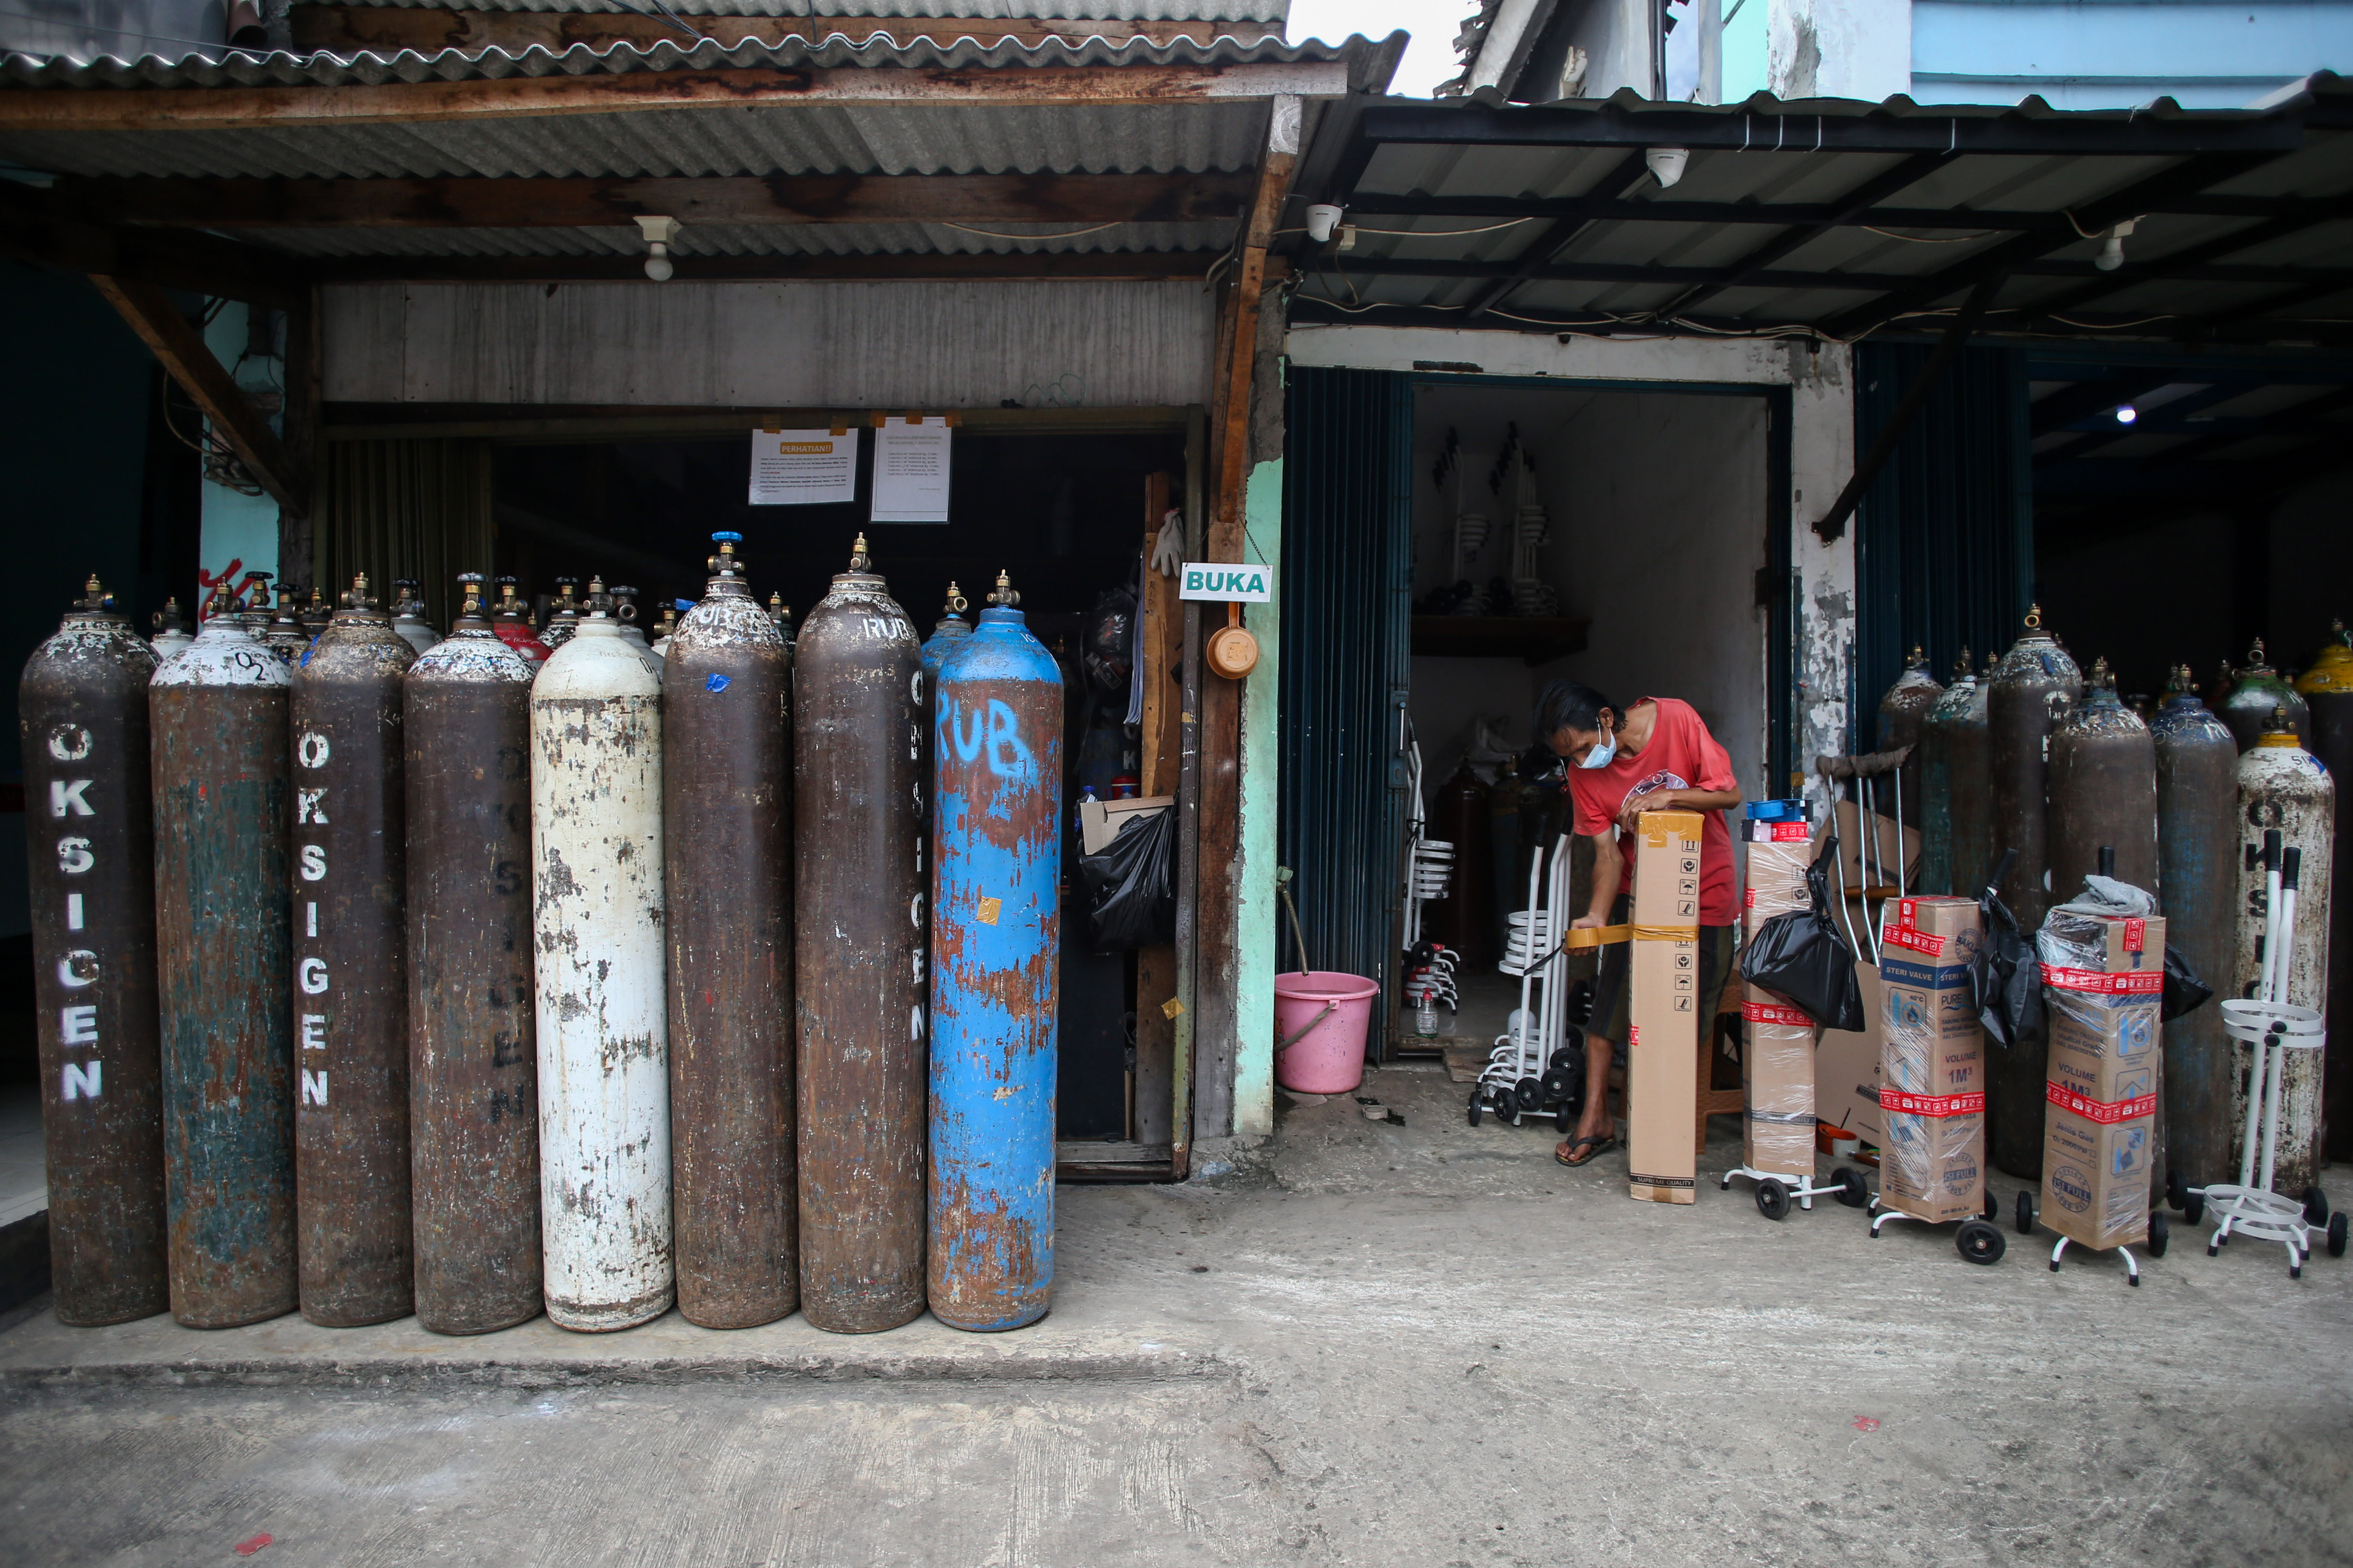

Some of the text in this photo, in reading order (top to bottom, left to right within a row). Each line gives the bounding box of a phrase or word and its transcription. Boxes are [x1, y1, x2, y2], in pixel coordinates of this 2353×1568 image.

[1186, 571, 1265, 593] BUKA
[936, 691, 1037, 777] RUB
[49, 723, 102, 1100] OKSIGEN
[297, 731, 330, 1106] OKSIGEN
[1886, 966, 1933, 981] STERI VALVE
[1940, 972, 1959, 982] STERI
[1941, 993, 1962, 1005] PURE
[1946, 1052, 1976, 1063] VOLUME
[2058, 1062, 2096, 1083] VOLUME
[1943, 1115, 1961, 1123] Jenis
[2055, 1122, 2095, 1143] Jenis Gas
[1637, 1176, 1665, 1185] SUPREME
[1956, 1169, 1975, 1179] FULL
[2053, 1179, 2090, 1201] ISI FULL
